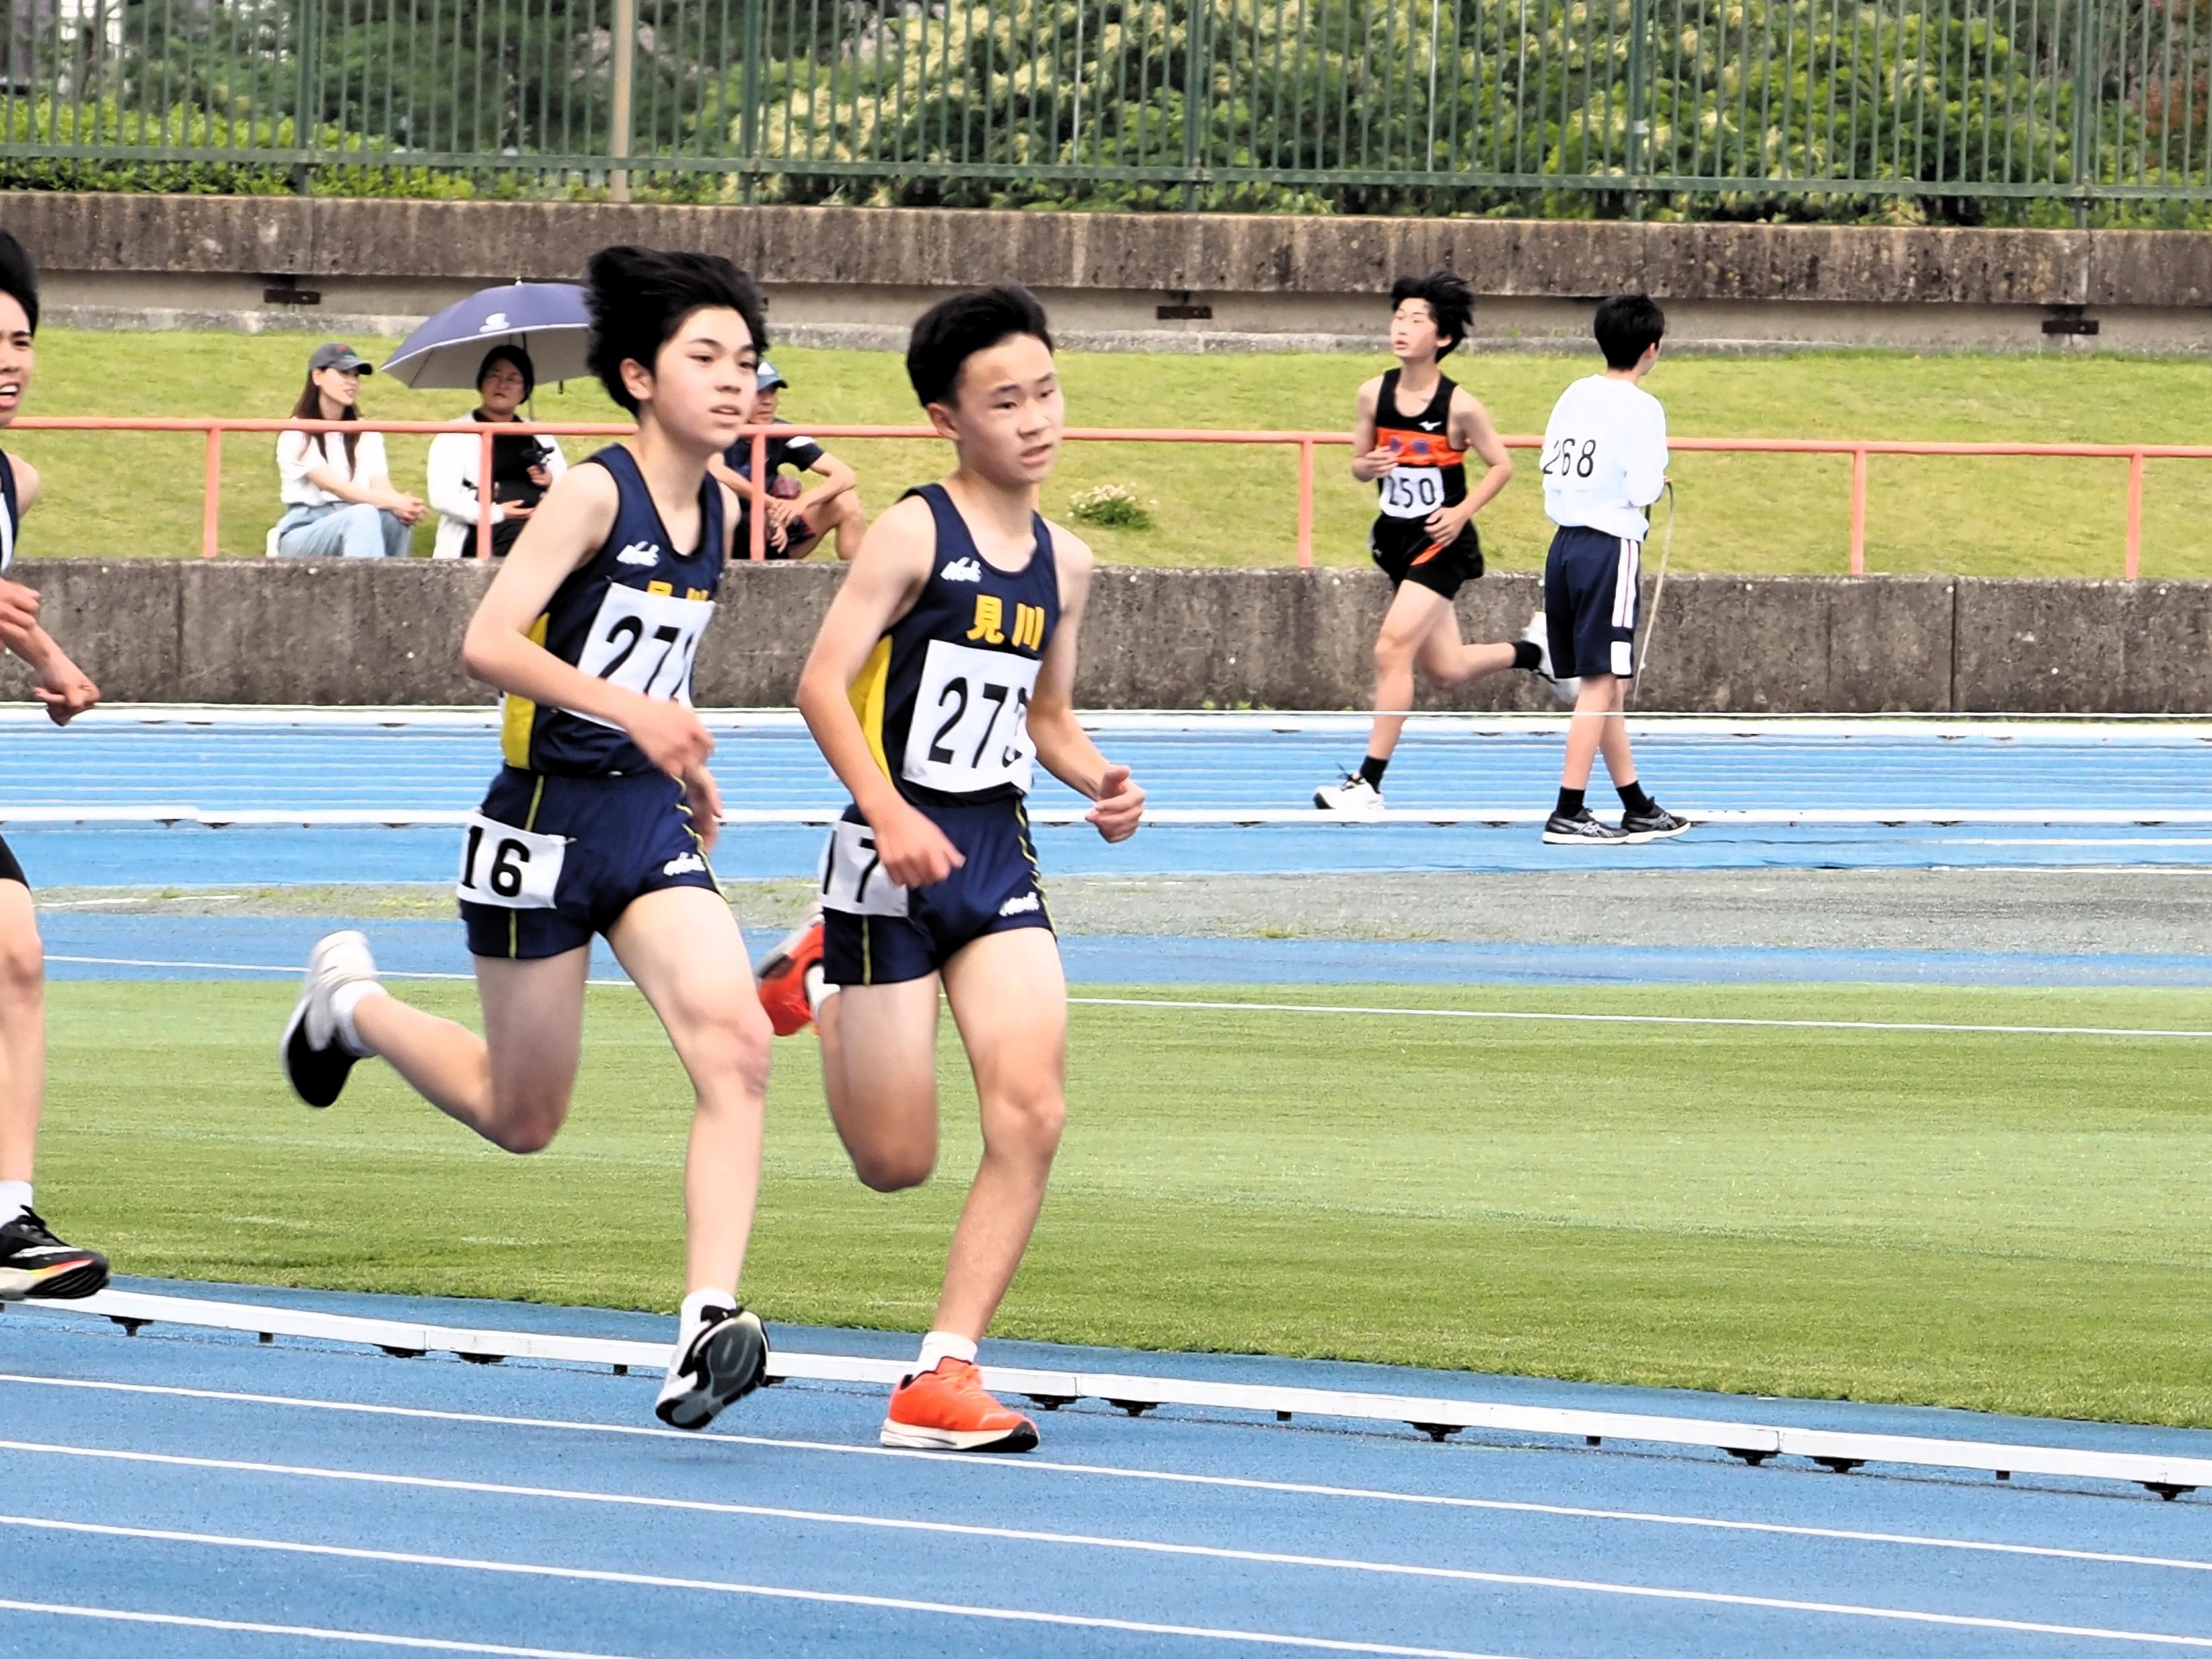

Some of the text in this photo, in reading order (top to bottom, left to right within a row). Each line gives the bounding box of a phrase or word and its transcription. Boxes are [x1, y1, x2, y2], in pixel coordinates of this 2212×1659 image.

[1542, 437, 1597, 478] 268
[965, 593, 1046, 652] 見川
[462, 825, 531, 898] 16
[823, 830, 880, 903] 17
